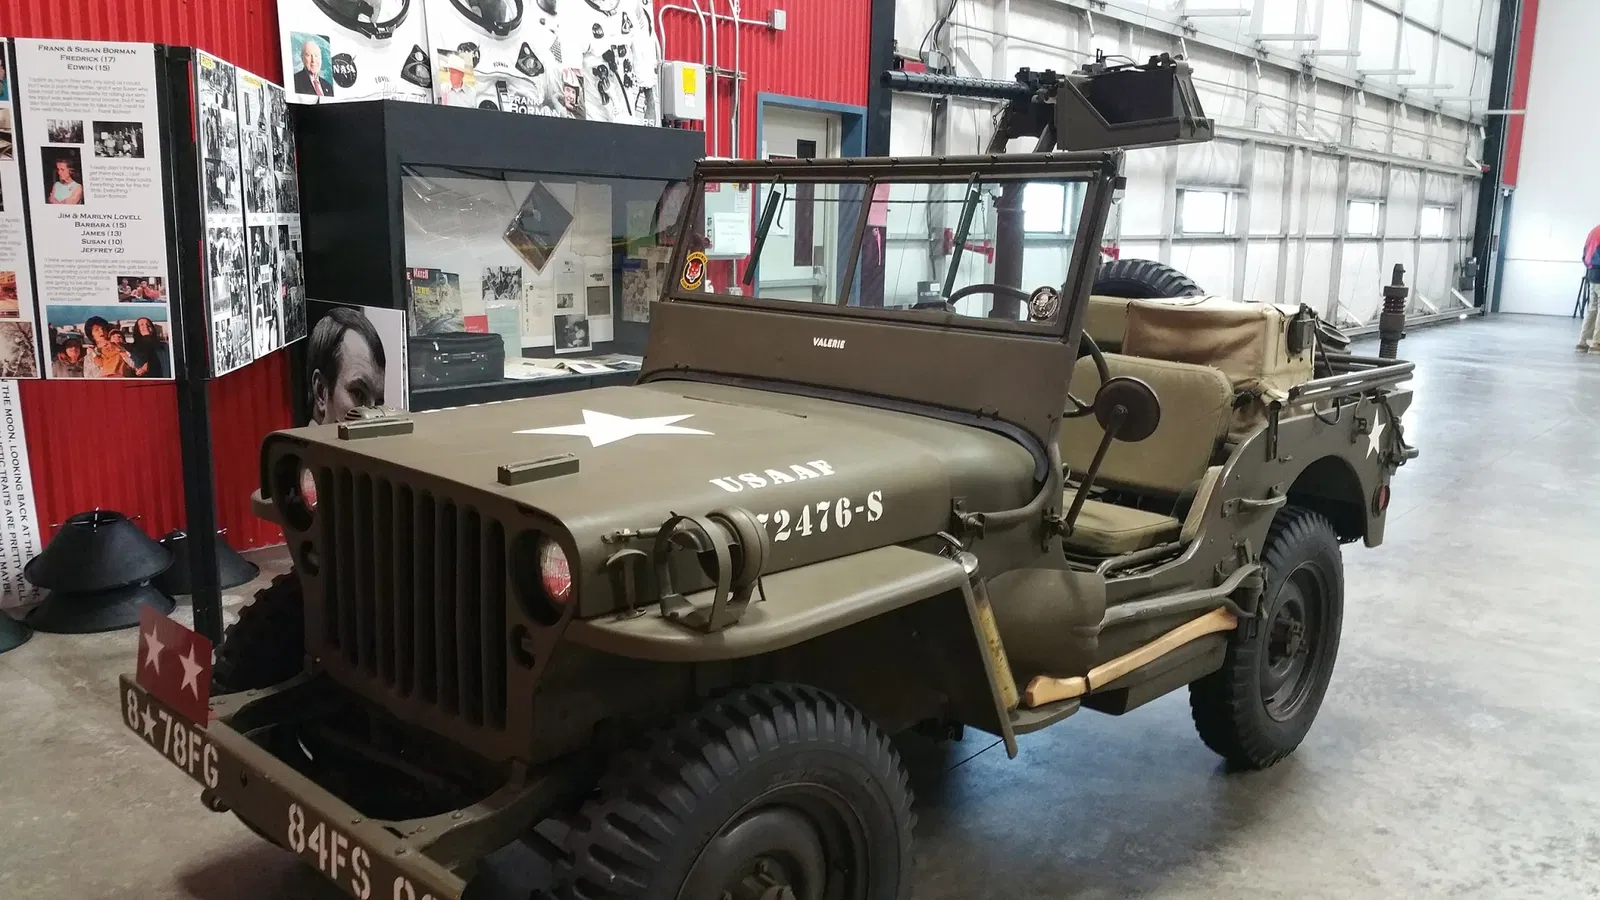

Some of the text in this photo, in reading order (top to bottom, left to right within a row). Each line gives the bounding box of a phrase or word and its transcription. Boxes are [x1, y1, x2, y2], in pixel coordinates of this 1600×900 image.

[38, 44, 66, 52] FRANK
[103, 47, 137, 55] BORMAN
[60, 54, 99, 62] FREDRICK
[333, 65, 356, 74] NASA
[509, 95, 542, 106] FRANK
[813, 337, 846, 349] VALERIE
[2, 385, 11, 406] THE
[4, 408, 16, 442] MOON,
[10, 445, 23, 491] LOOKING
[709, 459, 835, 493] USAAF
[0, 470, 12, 506] TRAITS
[5, 509, 15, 529] ARE
[17, 494, 28, 522] BACK
[22, 525, 31, 538] AT
[10, 532, 22, 569] PRETTY
[25, 540, 34, 560] THE
[0, 562, 12, 596] MAYBE
[16, 573, 27, 601] WELL
[288, 802, 372, 900] 84FS
